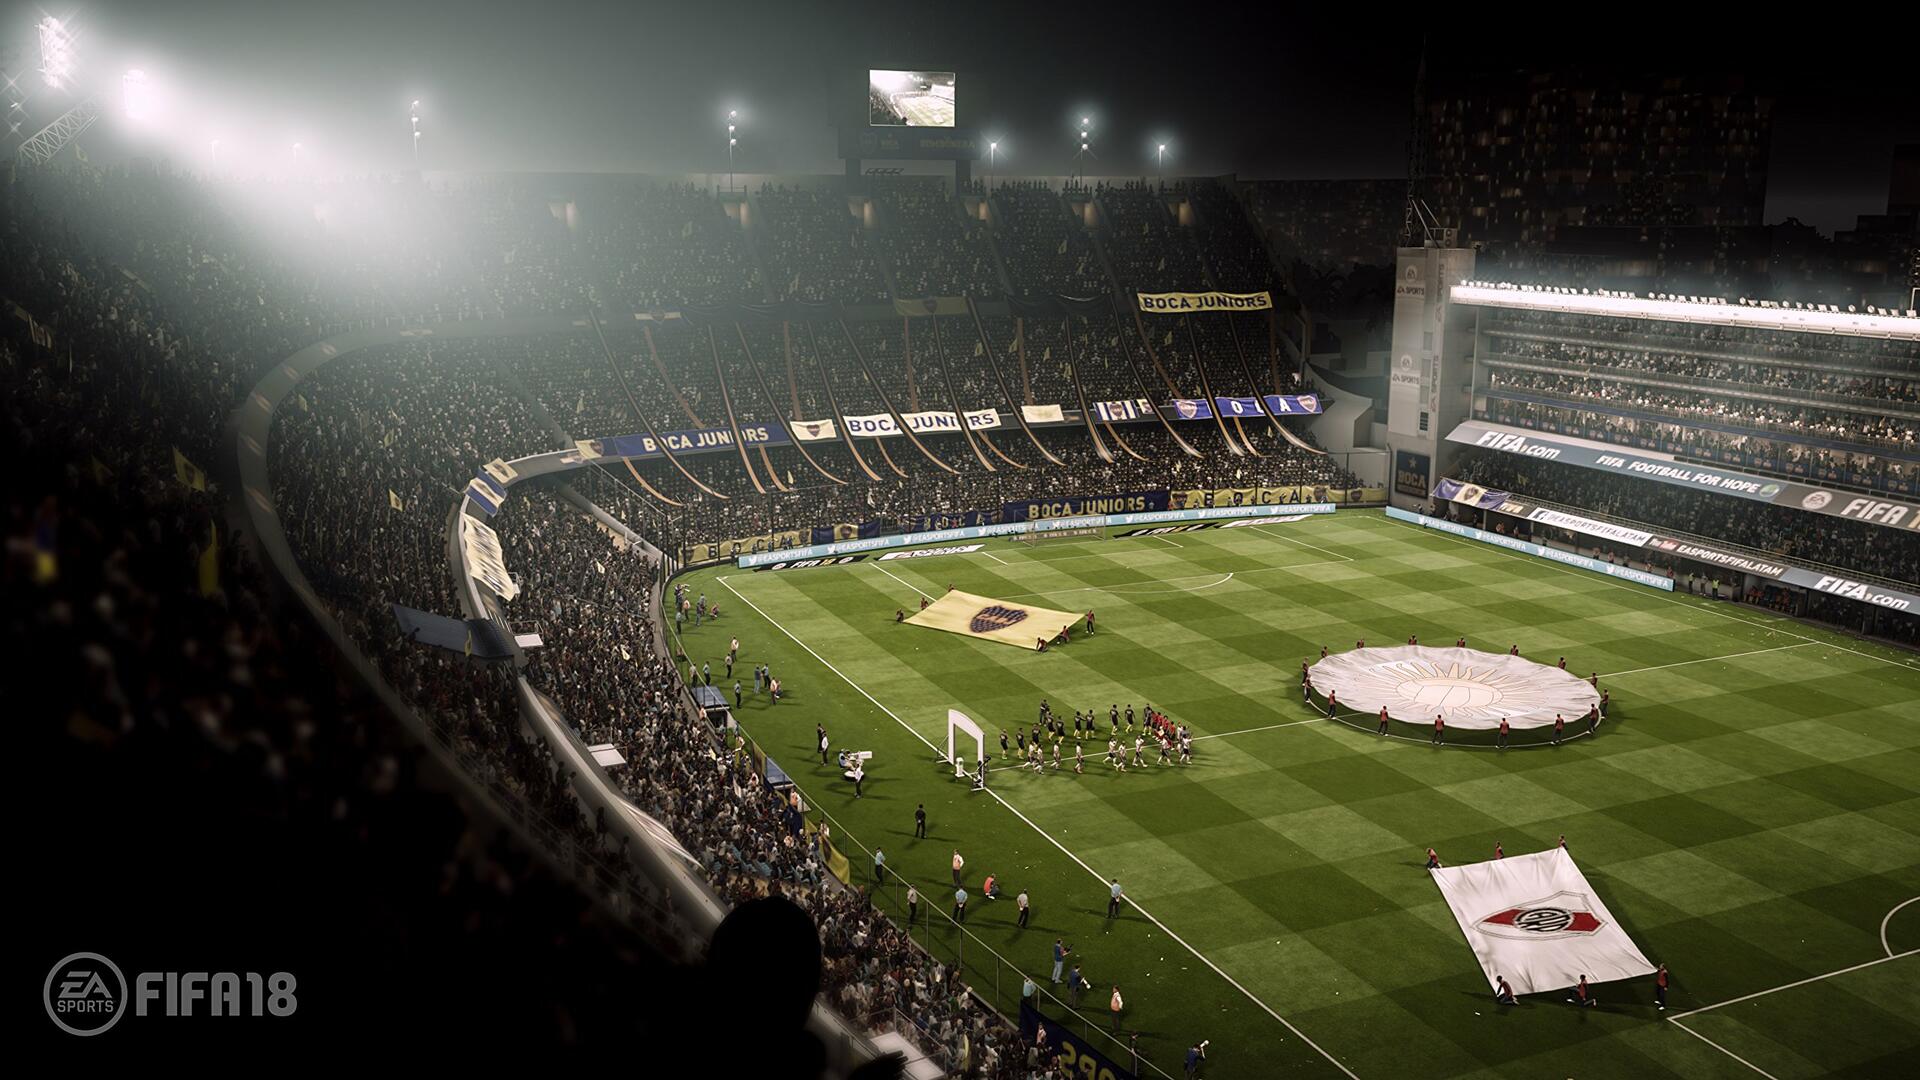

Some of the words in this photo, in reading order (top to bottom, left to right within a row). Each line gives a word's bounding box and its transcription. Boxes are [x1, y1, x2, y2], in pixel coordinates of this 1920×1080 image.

[1144, 297, 1191, 309] BOCA
[1195, 295, 1267, 308] JUNIORS
[1475, 430, 1561, 460] FIFA.com
[1397, 469, 1427, 489] BOCA
[1595, 455, 1625, 468] FIFA
[1628, 461, 1691, 482] FOOTBALL
[1691, 473, 1721, 488] FOR
[1719, 478, 1762, 494] HOPE
[1028, 502, 1073, 519] BOCA
[1076, 496, 1146, 516] JUNIORS
[1840, 498, 1909, 525] FIFA
[1677, 545, 1784, 576] EASPORTSFIFALATAM
[1813, 575, 1911, 610] FIFA.com
